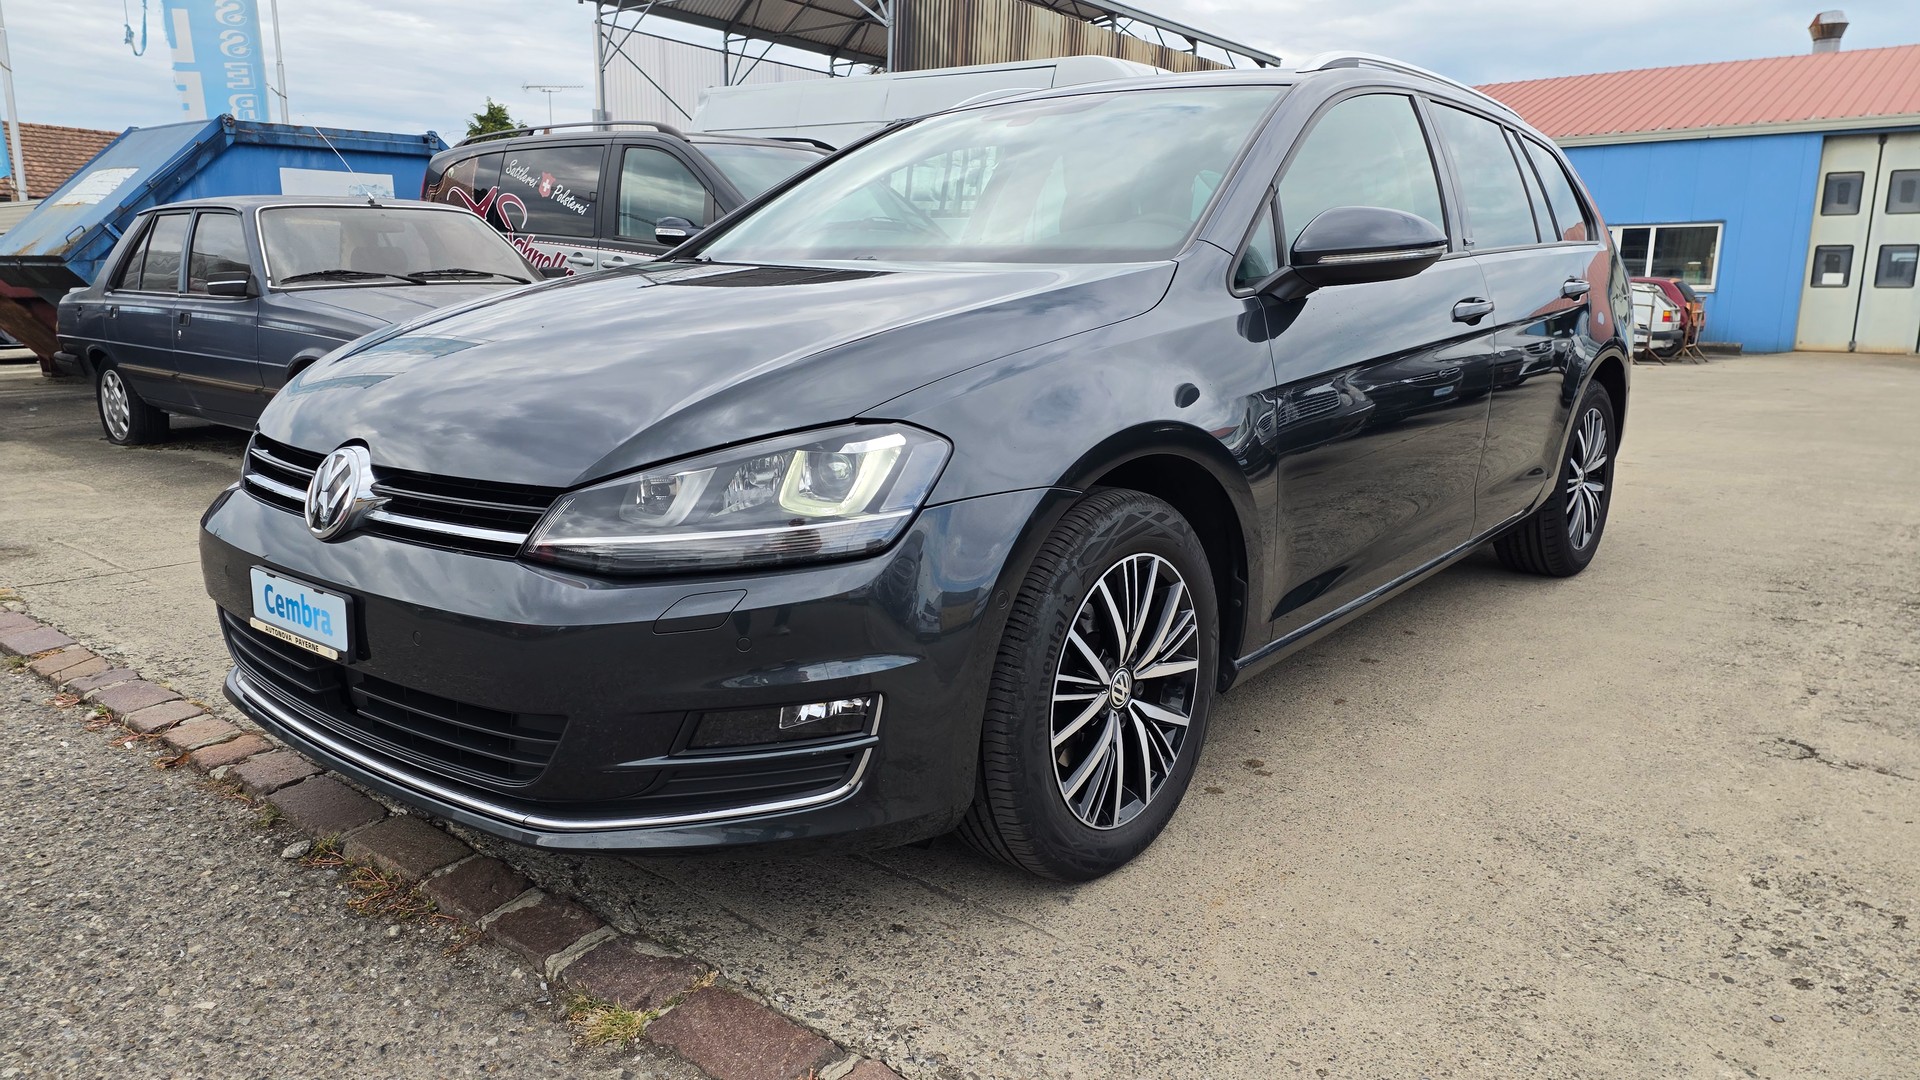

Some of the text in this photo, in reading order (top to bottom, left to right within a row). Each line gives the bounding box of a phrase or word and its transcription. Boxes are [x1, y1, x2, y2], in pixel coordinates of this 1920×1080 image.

[505, 159, 590, 216] Sattlerei Polsterei
[264, 584, 333, 637] Cembra
[265, 625, 319, 652] AUTONOVA PAYERNE
